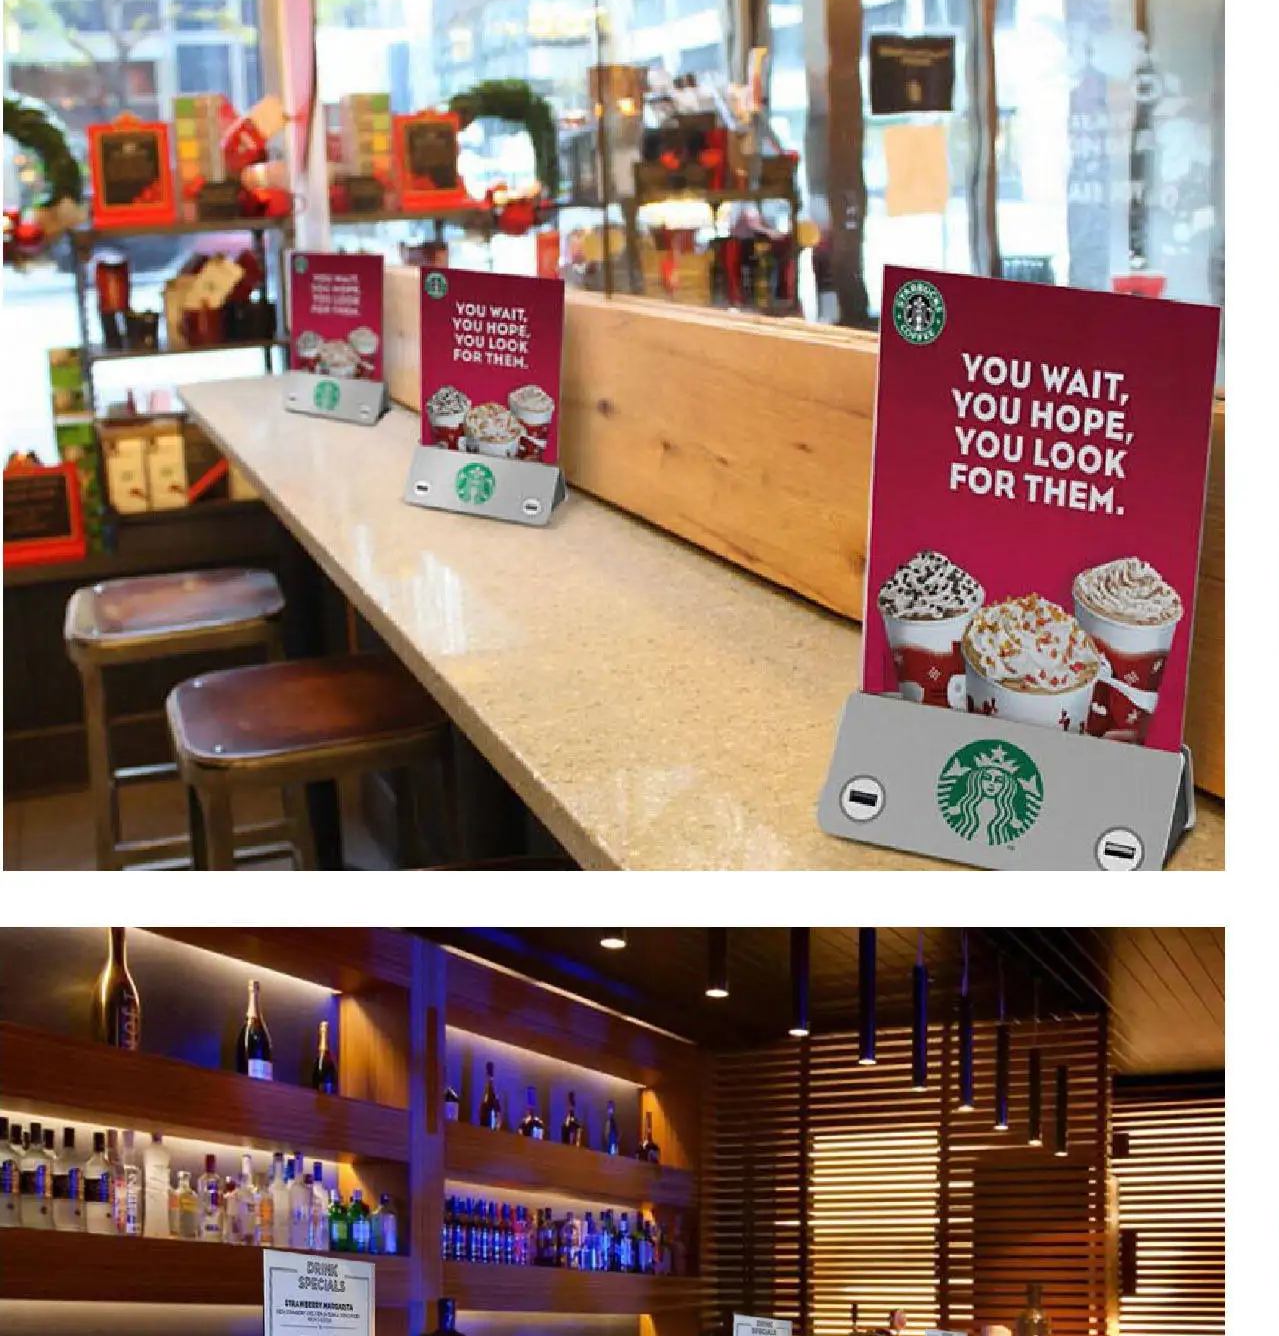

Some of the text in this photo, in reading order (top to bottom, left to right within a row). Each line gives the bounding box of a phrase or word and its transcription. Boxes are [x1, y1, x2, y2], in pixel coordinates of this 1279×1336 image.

[456, 301, 486, 318] YOU
[453, 317, 483, 333] YOU
[455, 332, 528, 354] YOU LOOK
[453, 348, 483, 363] FOR
[961, 353, 1130, 405] YOU WAIT,
[952, 388, 1135, 445] YOU HOPE,
[954, 425, 1126, 479] YOU LOOK
[949, 462, 1125, 516] FOR THEM.
[306, 1261, 339, 1277] DRINK
[298, 1275, 346, 1293] SPECIALS
